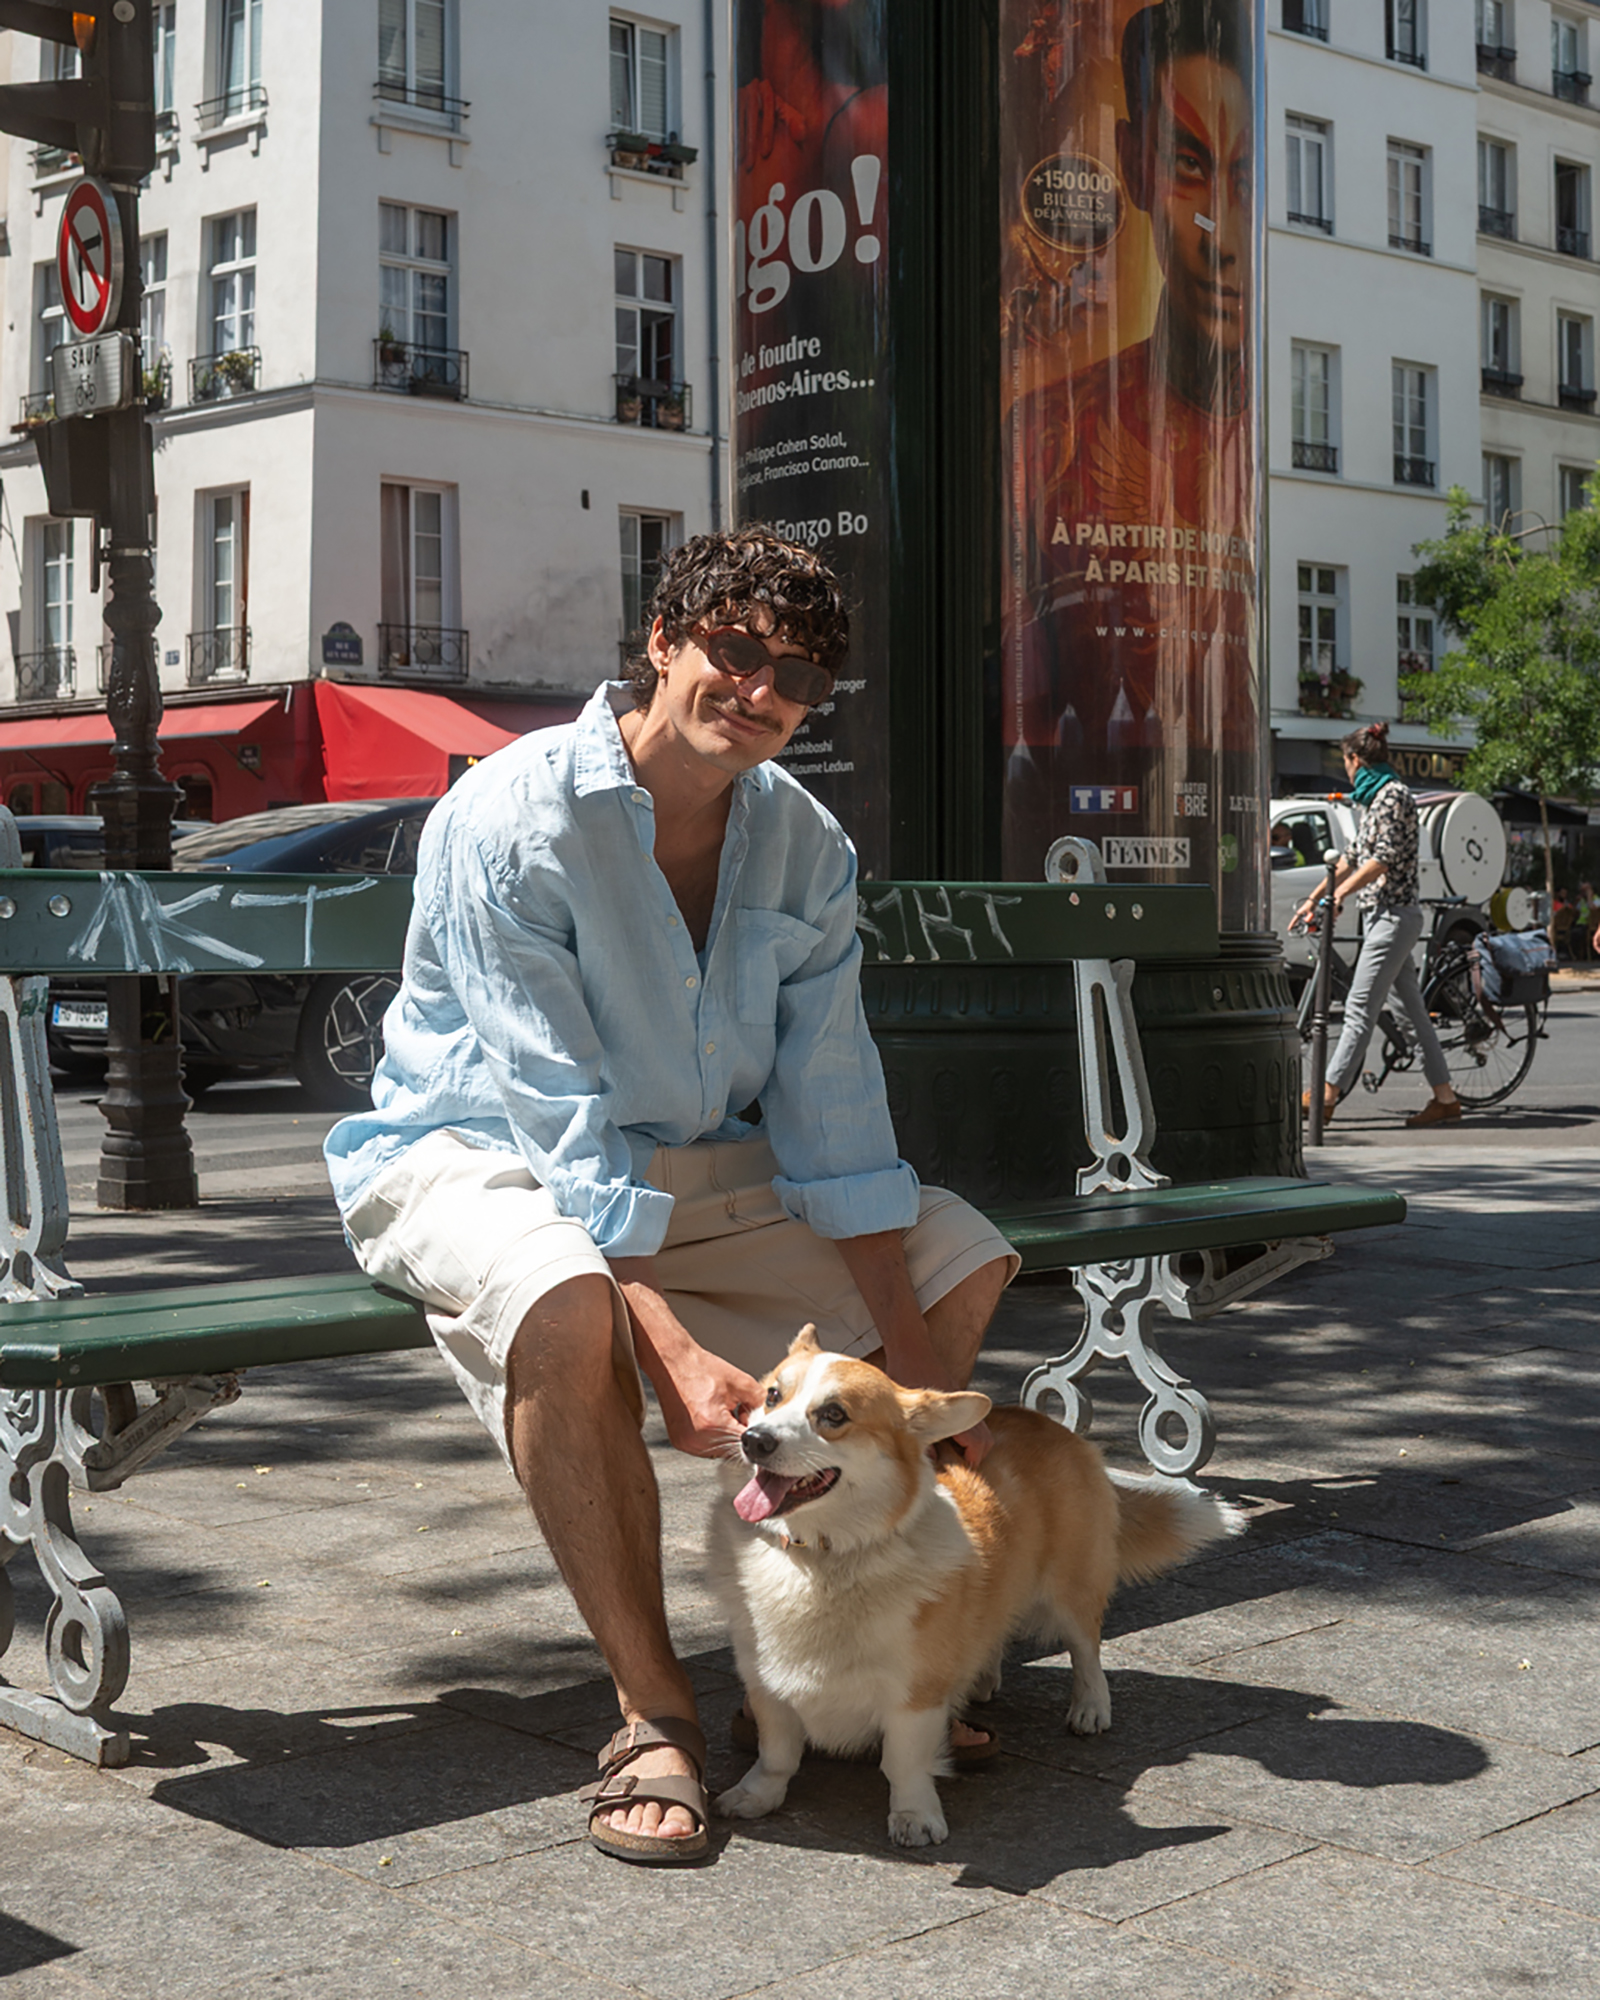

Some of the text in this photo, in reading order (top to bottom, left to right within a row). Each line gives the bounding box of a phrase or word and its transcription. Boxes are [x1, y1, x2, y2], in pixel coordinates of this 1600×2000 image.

[1043, 192, 1105, 210] BILLETS
[1065, 209, 1114, 224] VENDUS
[71, 344, 100, 369] SAUF
[740, 352, 756, 378] de
[759, 335, 821, 371] foudre
[776, 438, 808, 457] Cohen
[809, 431, 847, 450] Solal,
[764, 460, 810, 482] Francisco
[812, 455, 870, 473] Canaro...
[775, 517, 832, 548] Fonzo
[837, 510, 869, 537] Bo
[1051, 516, 1071, 545] À
[1075, 523, 1166, 549] PARTIR
[1172, 527, 1197, 551] DE
[1084, 554, 1104, 583] À
[1109, 560, 1181, 586] PARIS
[1186, 565, 1208, 588] ET
[1211, 570, 1230, 592] EN
[823, 759, 855, 774] Ledun
[1074, 788, 1133, 810] TF1
[1173, 781, 1209, 796] QUARTIER
[1105, 839, 1188, 865] FEMMES
